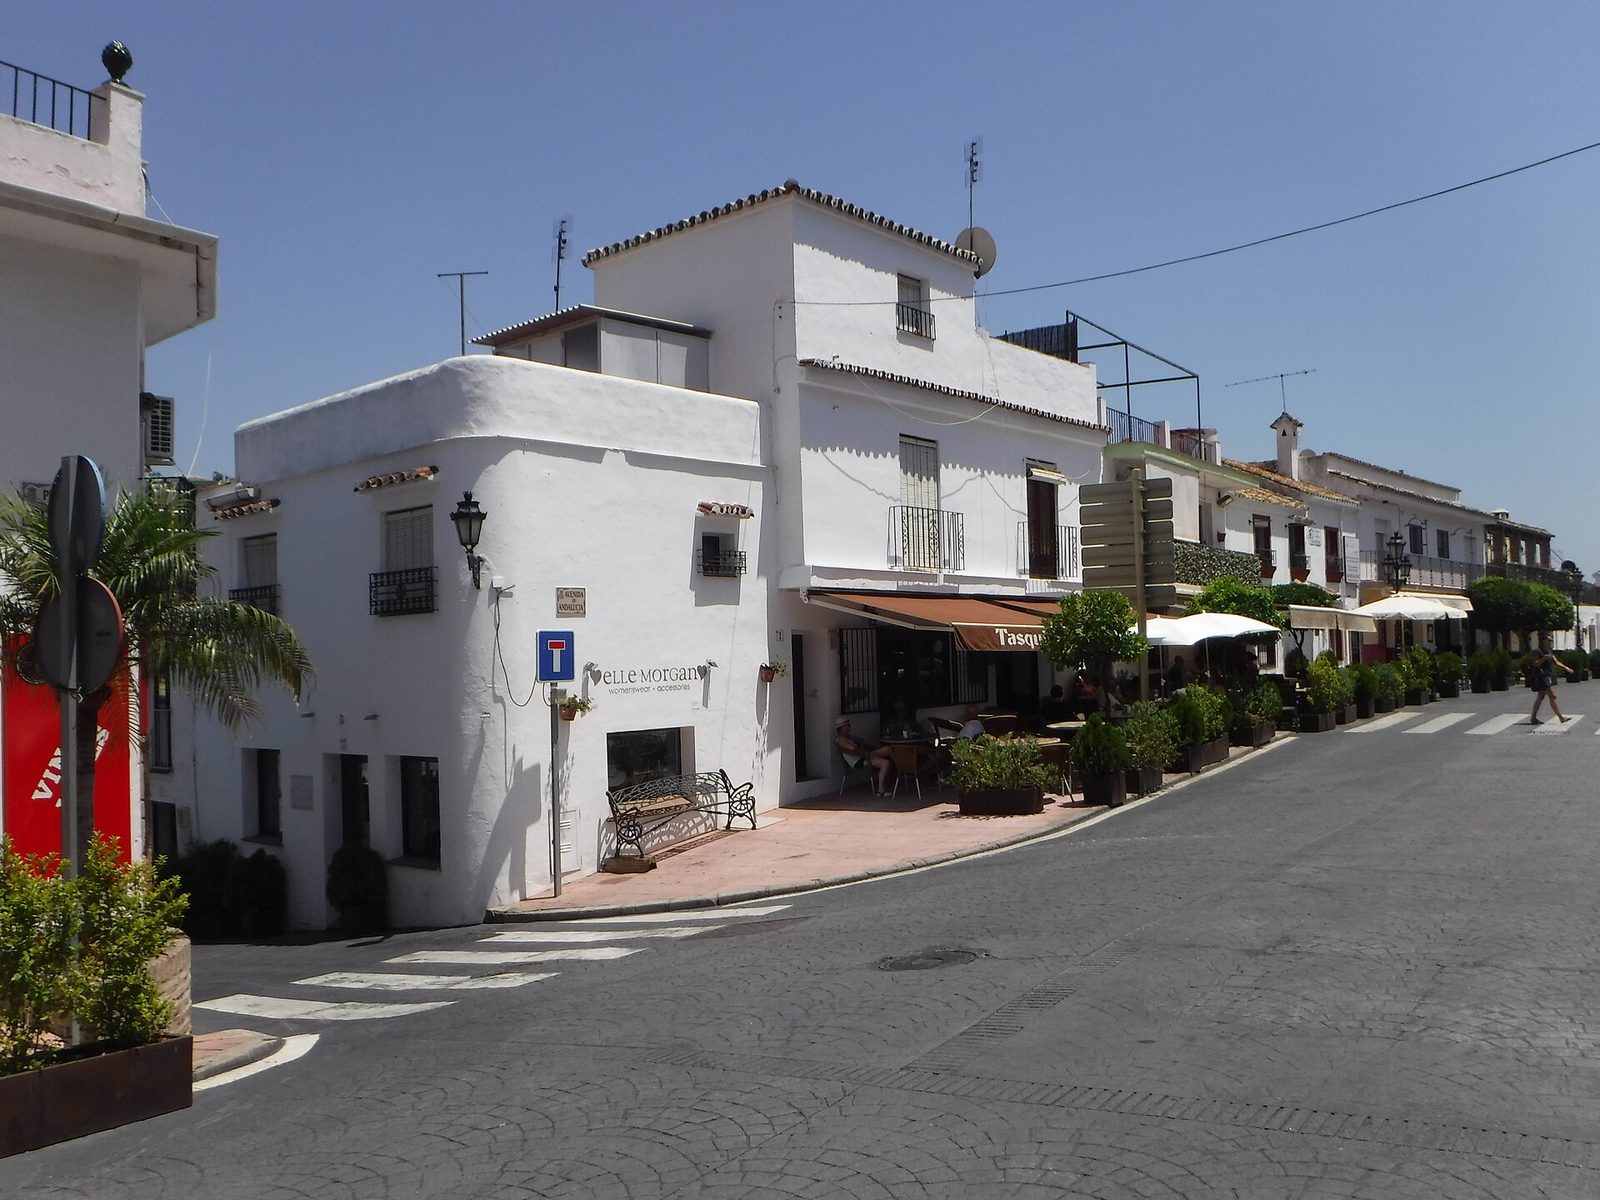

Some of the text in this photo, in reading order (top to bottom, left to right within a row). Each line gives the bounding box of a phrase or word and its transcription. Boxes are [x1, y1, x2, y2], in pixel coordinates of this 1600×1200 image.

[995, 628, 1042, 649] Tasqu
[608, 683, 691, 695] womenswear accessories
